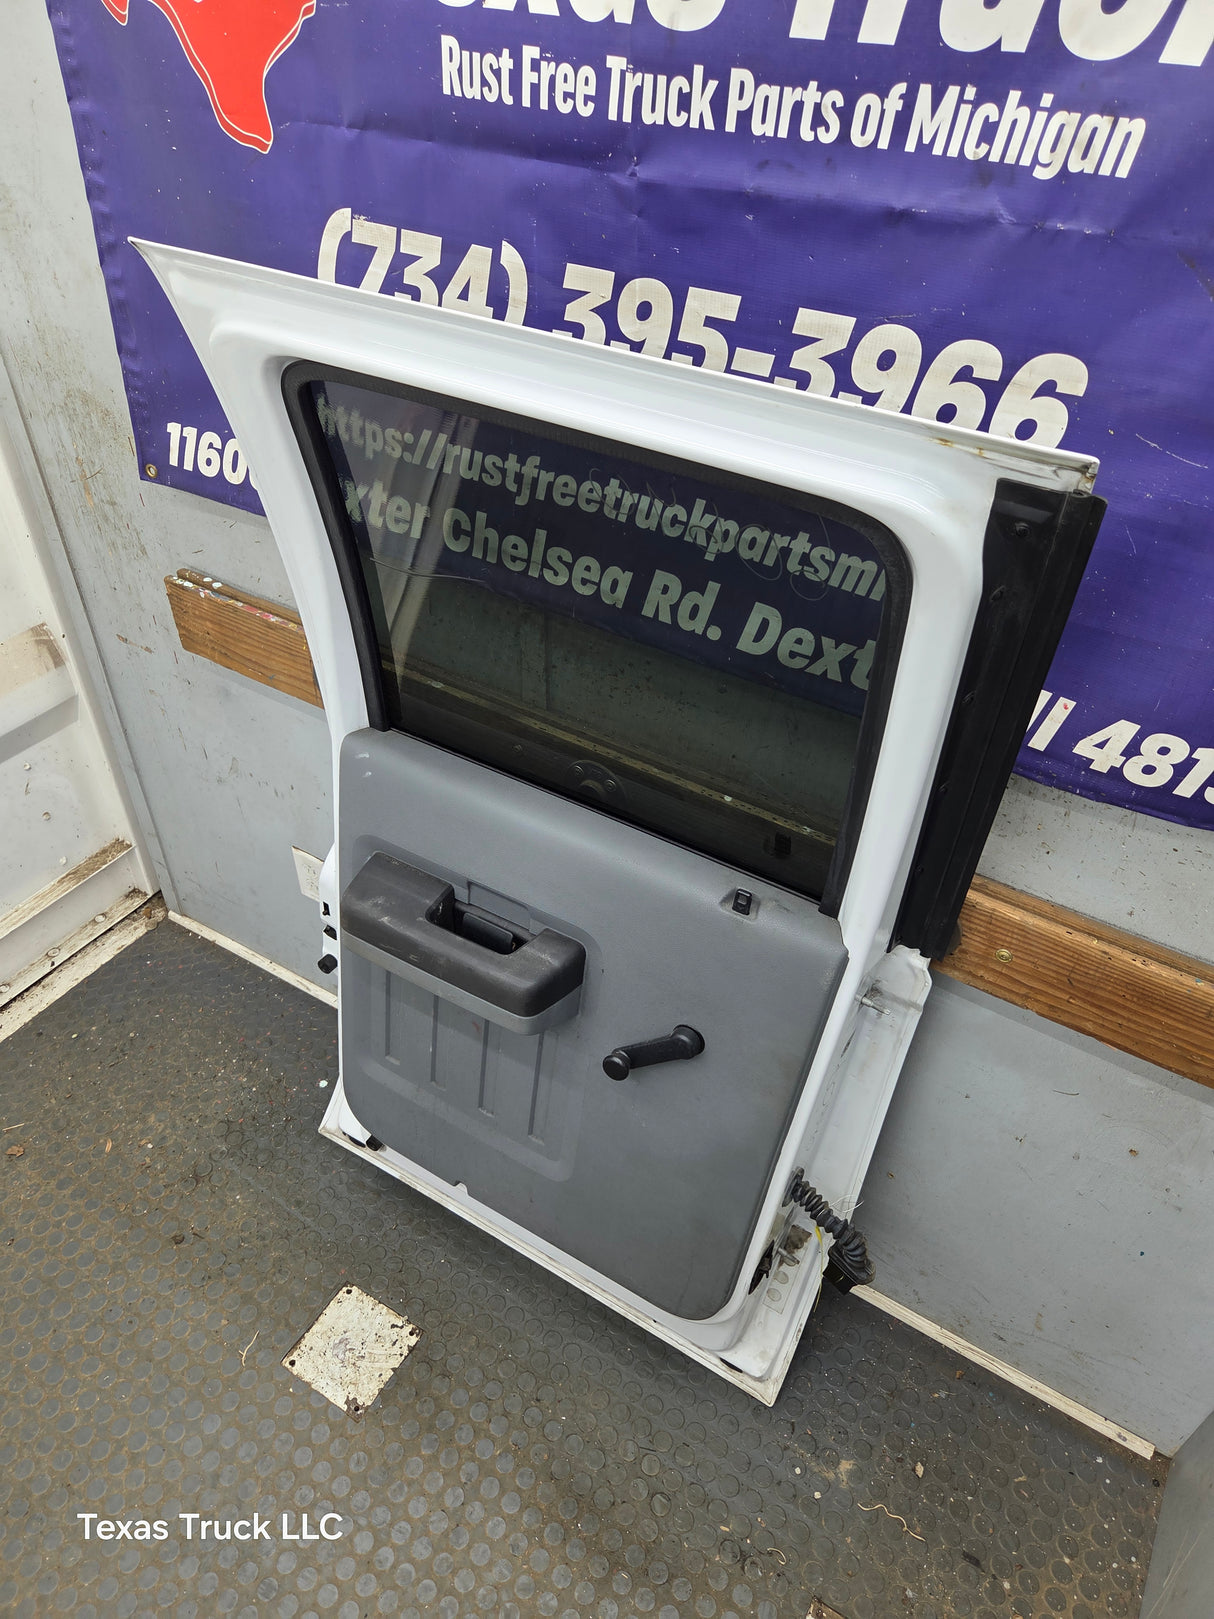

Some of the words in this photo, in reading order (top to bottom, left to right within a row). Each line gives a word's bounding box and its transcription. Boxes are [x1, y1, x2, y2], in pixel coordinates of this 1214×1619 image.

[440, 34, 514, 106] Rust
[521, 45, 597, 117] Free
[605, 54, 720, 131] Truck
[724, 67, 845, 145] Parts
[849, 82, 908, 150] of
[903, 83, 1147, 181] Michigan
[317, 207, 529, 326] (734)
[552, 262, 1089, 450] 395-3966
[166, 421, 258, 492] 1160
[442, 507, 634, 609] Chelsea
[640, 569, 723, 641] Rd.
[1072, 719, 1214, 806] 481
